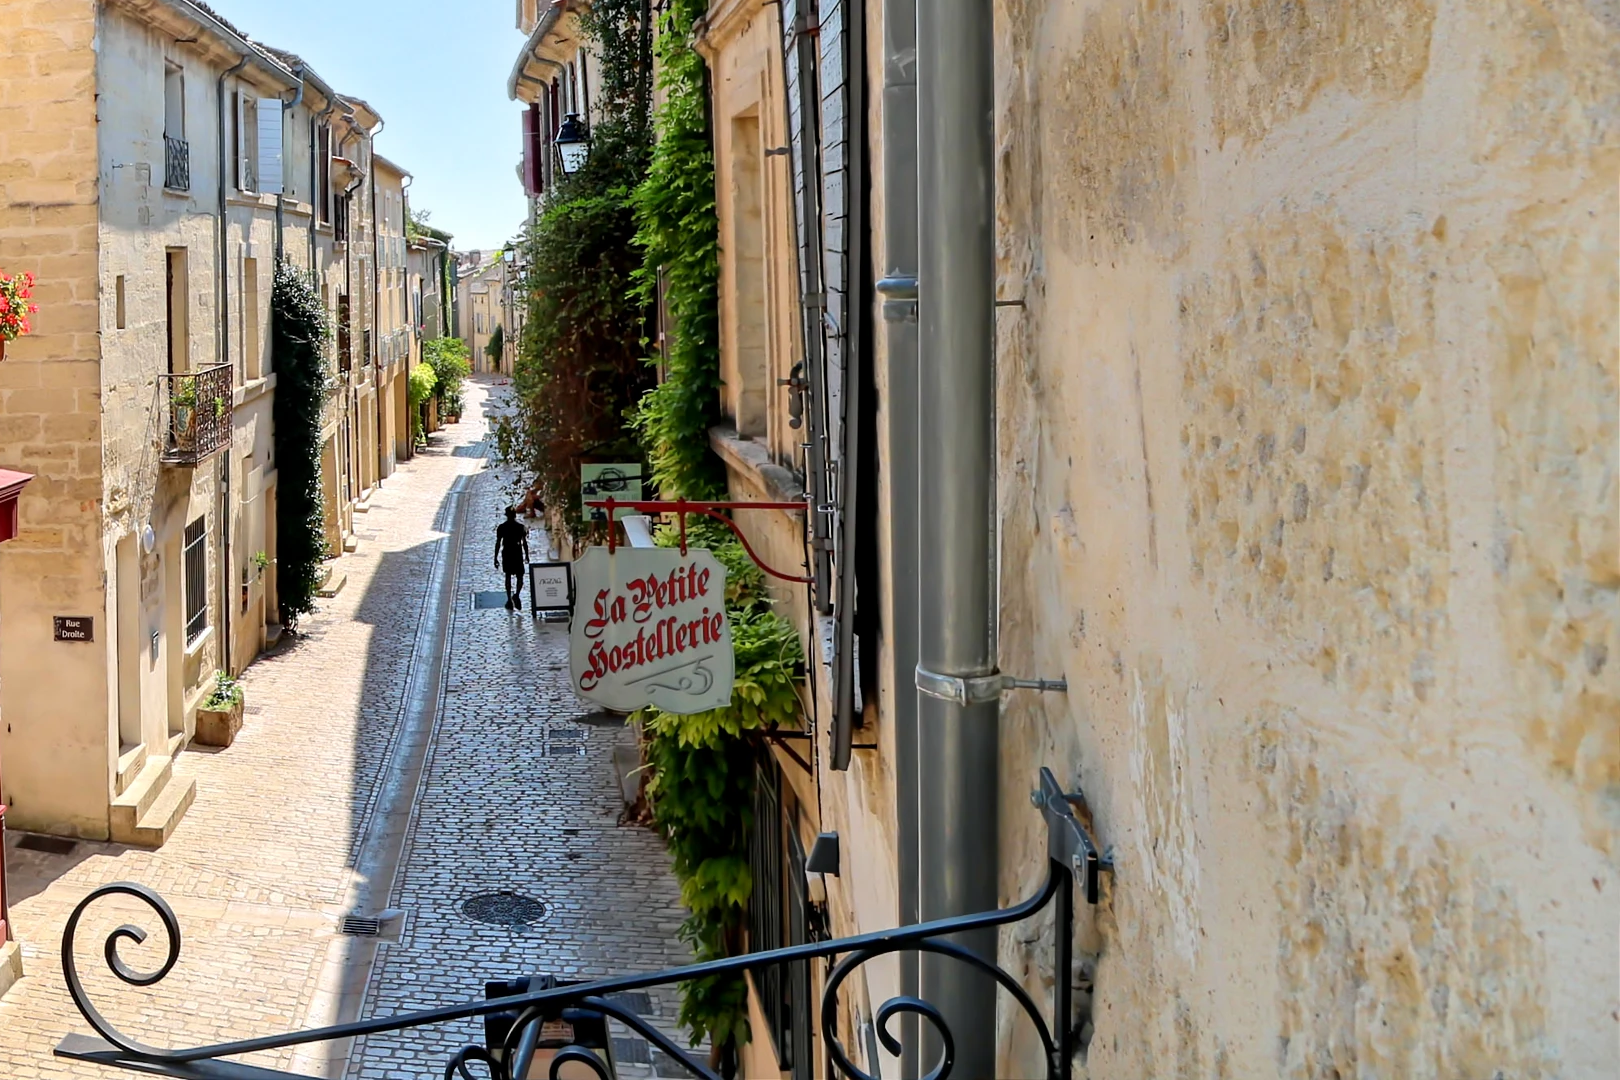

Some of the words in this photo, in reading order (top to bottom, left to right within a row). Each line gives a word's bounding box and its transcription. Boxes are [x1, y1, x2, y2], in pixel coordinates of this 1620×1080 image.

[584, 588, 627, 639] La
[626, 562, 710, 623] Petite
[62, 630, 85, 638] Droite
[65, 620, 81, 628] Rue
[580, 607, 722, 691] Hostellerie
